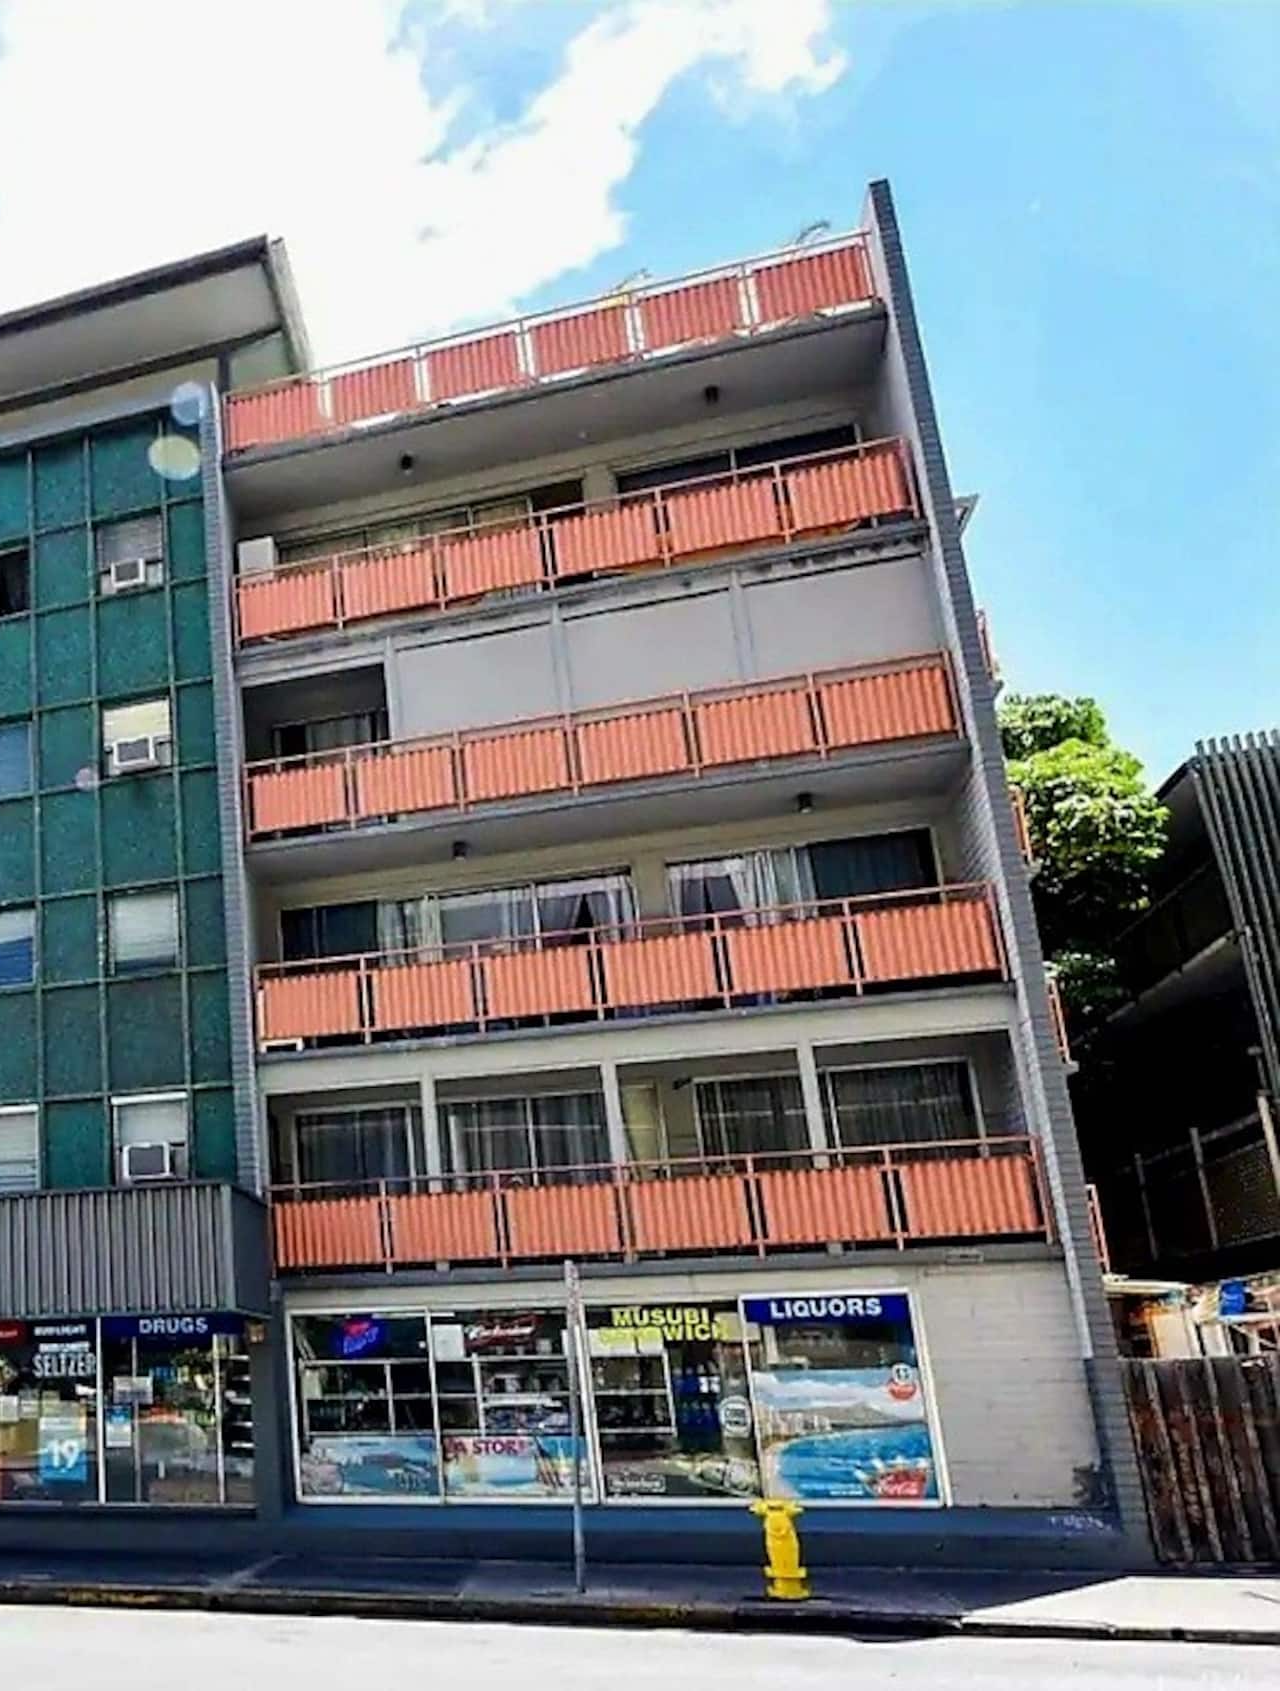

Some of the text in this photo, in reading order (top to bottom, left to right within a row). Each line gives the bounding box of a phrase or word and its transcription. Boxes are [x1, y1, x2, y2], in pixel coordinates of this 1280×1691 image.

[611, 1307, 709, 1326] MUSUBI
[770, 1298, 882, 1319] LIQUORS
[139, 1317, 208, 1334] DRUGS
[33, 1353, 97, 1377] SELTZER
